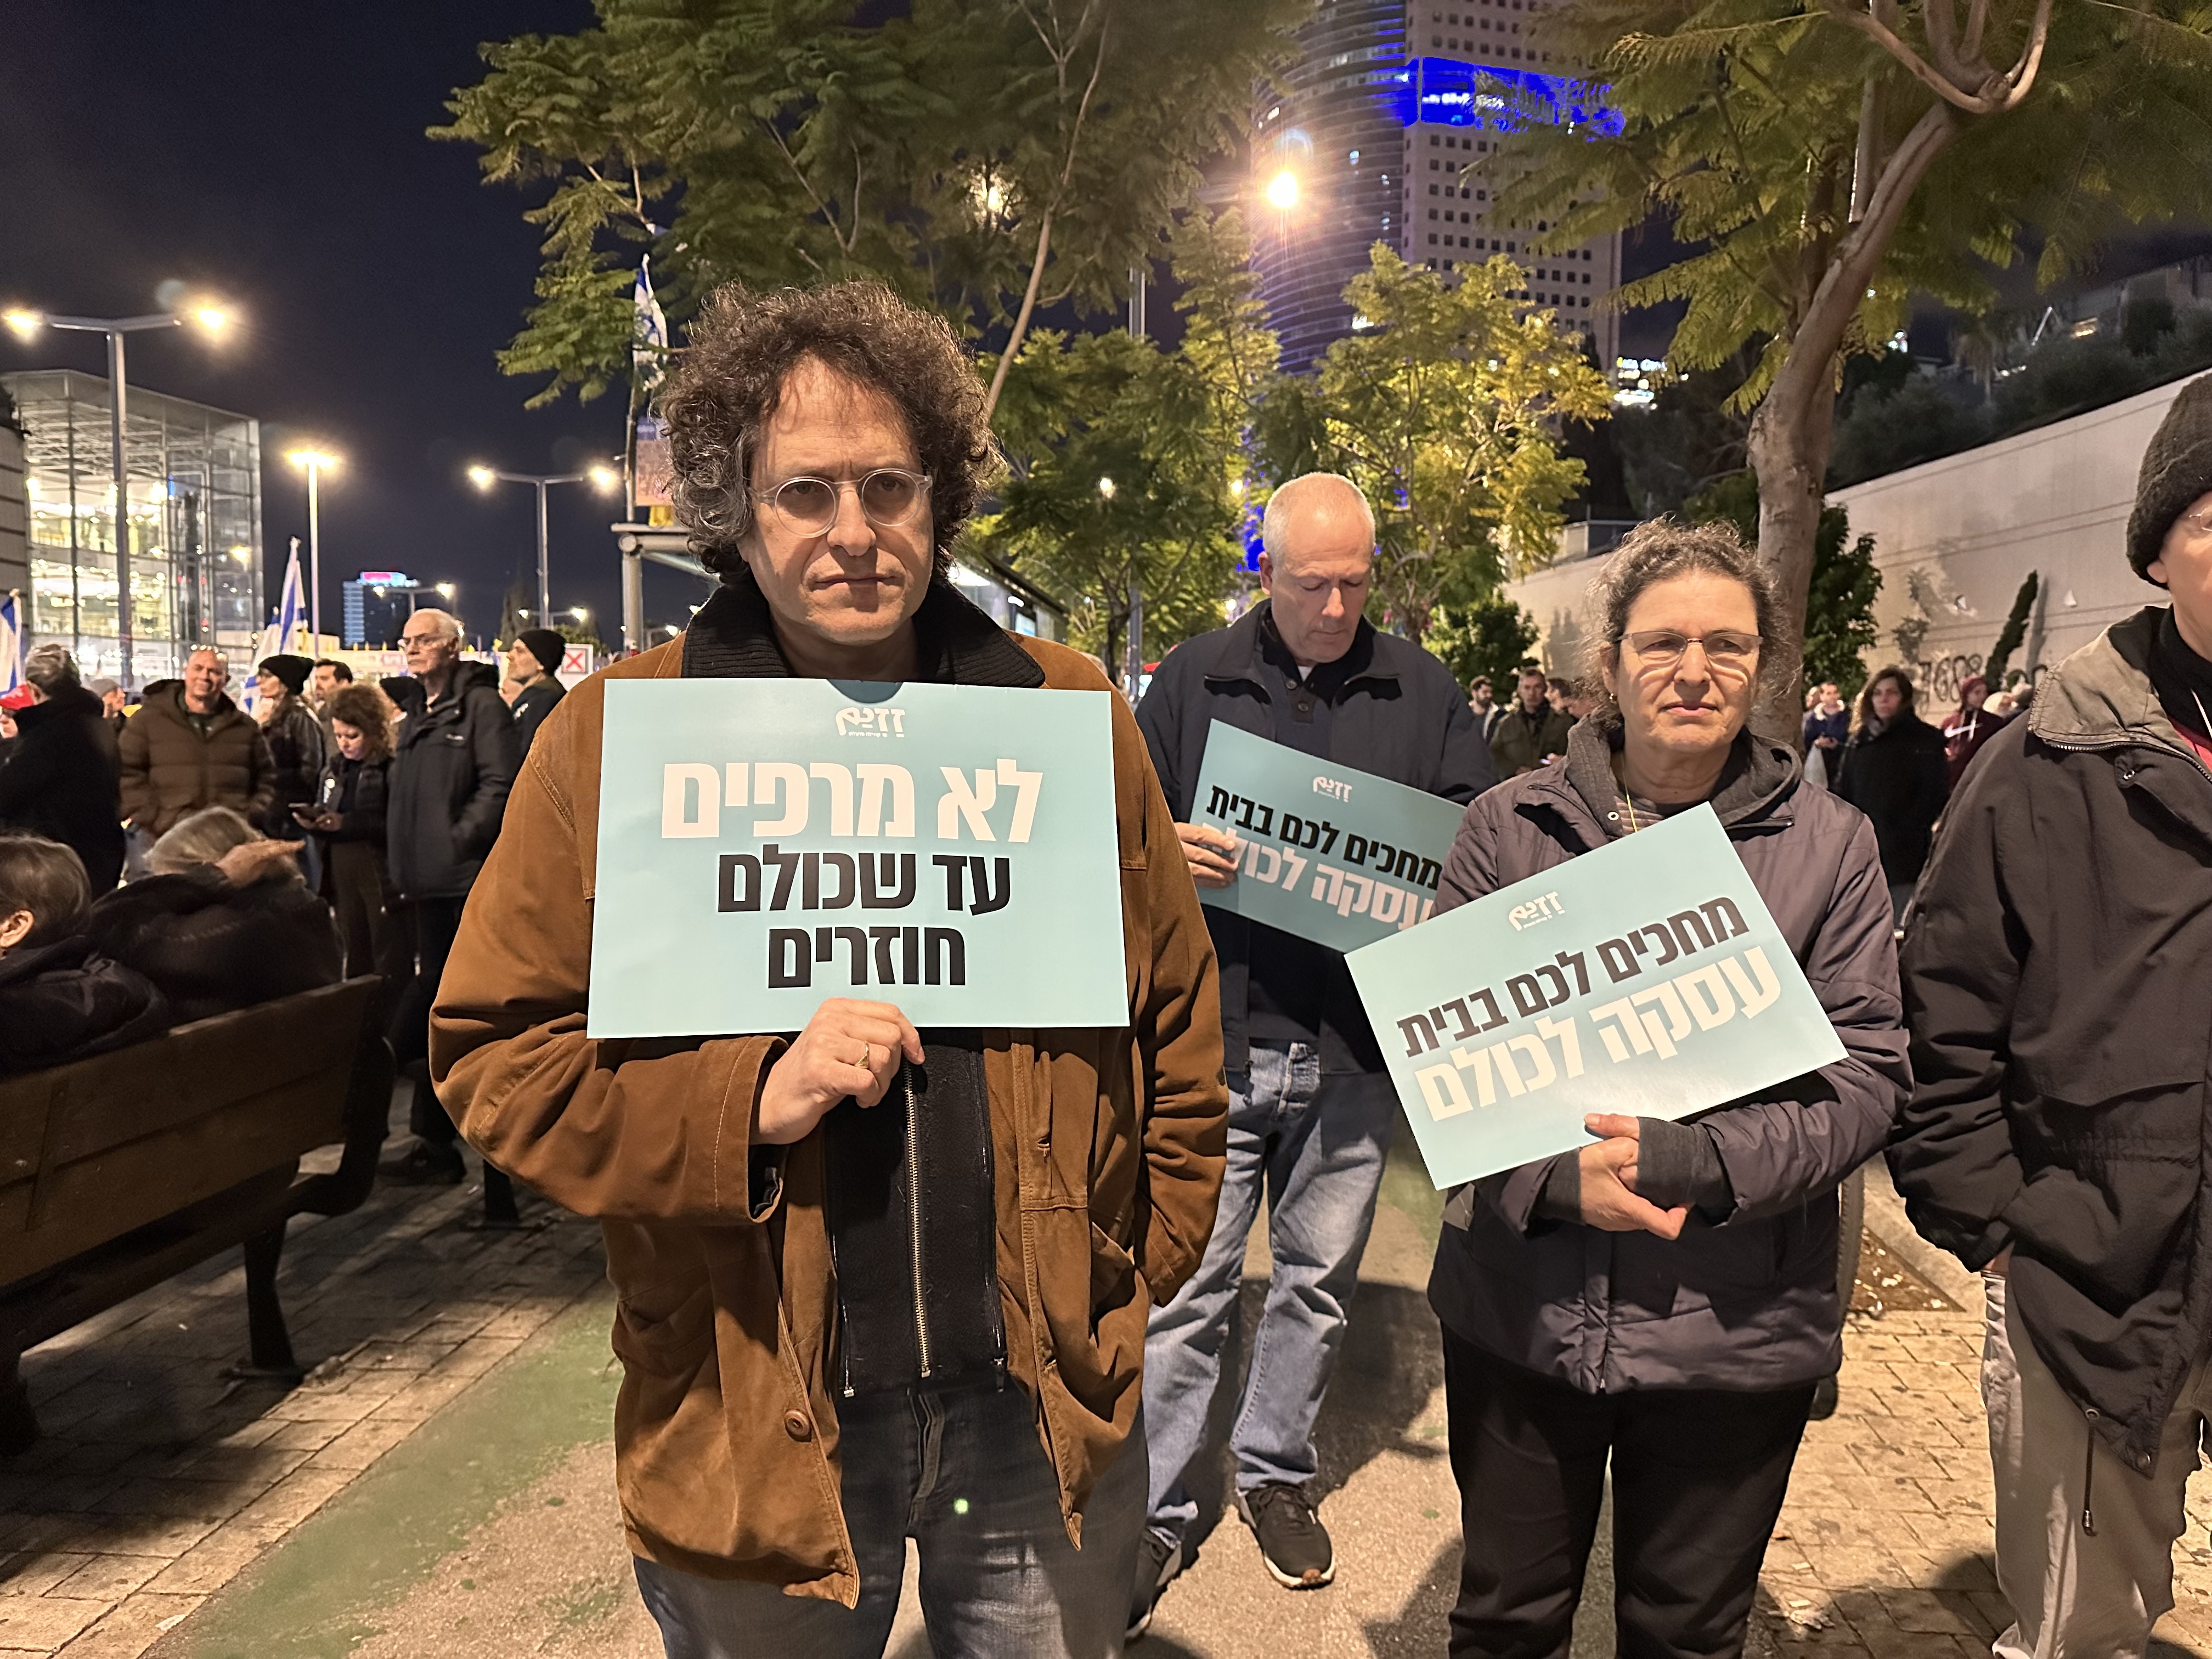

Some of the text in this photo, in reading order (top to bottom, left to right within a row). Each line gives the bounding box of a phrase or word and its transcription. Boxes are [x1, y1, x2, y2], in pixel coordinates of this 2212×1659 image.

[662, 759, 1043, 843] לא מרפים
[1206, 785, 1443, 891] מחכים לכם בבית
[718, 844, 1011, 916] עד שכולם
[1197, 822, 1435, 931] עסקה לכול
[768, 927, 966, 989] חוזרים
[1396, 897, 1750, 1058] מחכים לכם בבית
[1414, 946, 1781, 1121] עסקה לכולם
